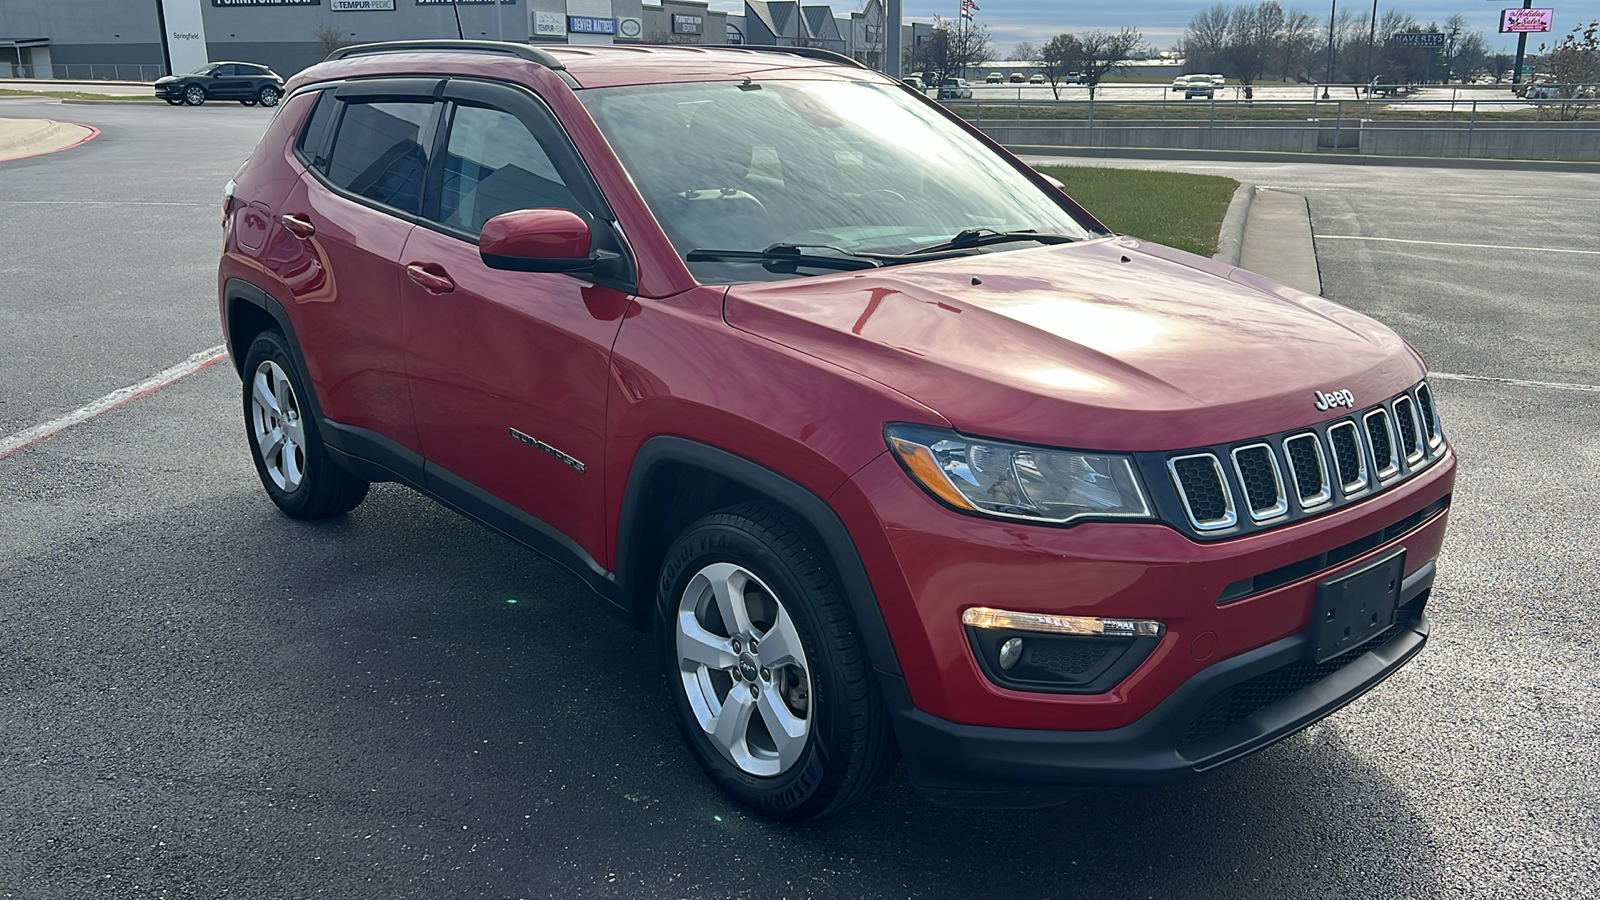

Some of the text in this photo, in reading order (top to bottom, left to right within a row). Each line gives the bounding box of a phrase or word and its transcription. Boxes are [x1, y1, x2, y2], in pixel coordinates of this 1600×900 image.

[1517, 9, 1546, 18] Holiday
[574, 18, 592, 31] DENVER
[593, 19, 613, 32] MATTRESS
[173, 32, 199, 41] Springfield
[1396, 34, 1443, 43] HAVERTYS
[1314, 388, 1355, 411] Jeep
[508, 427, 586, 473] COMPASS
